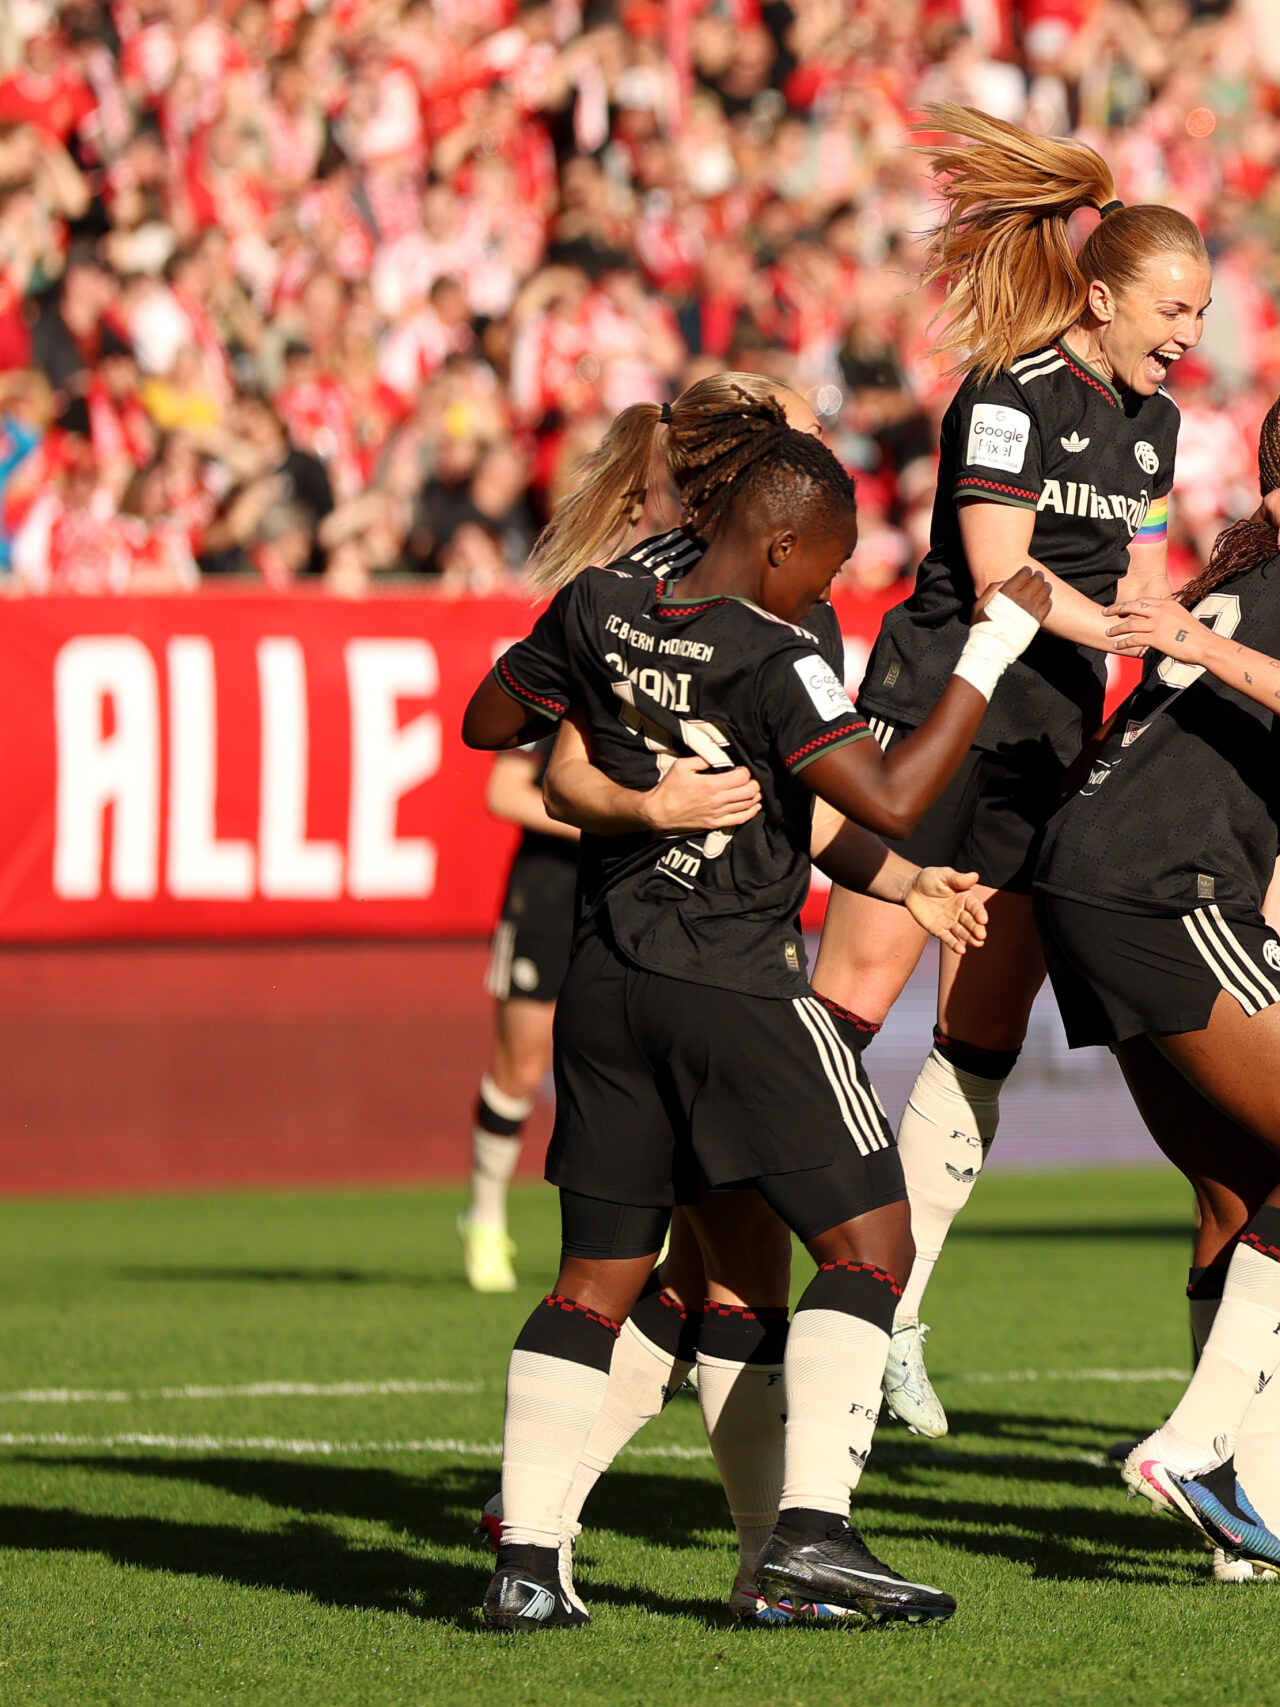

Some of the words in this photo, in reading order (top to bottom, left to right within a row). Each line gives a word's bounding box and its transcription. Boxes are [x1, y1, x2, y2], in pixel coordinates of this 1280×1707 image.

[974, 421, 1024, 443] Google
[978, 438, 1012, 457] Pixel
[1036, 478, 1141, 528] Allianz
[53, 634, 443, 901] ALLE
